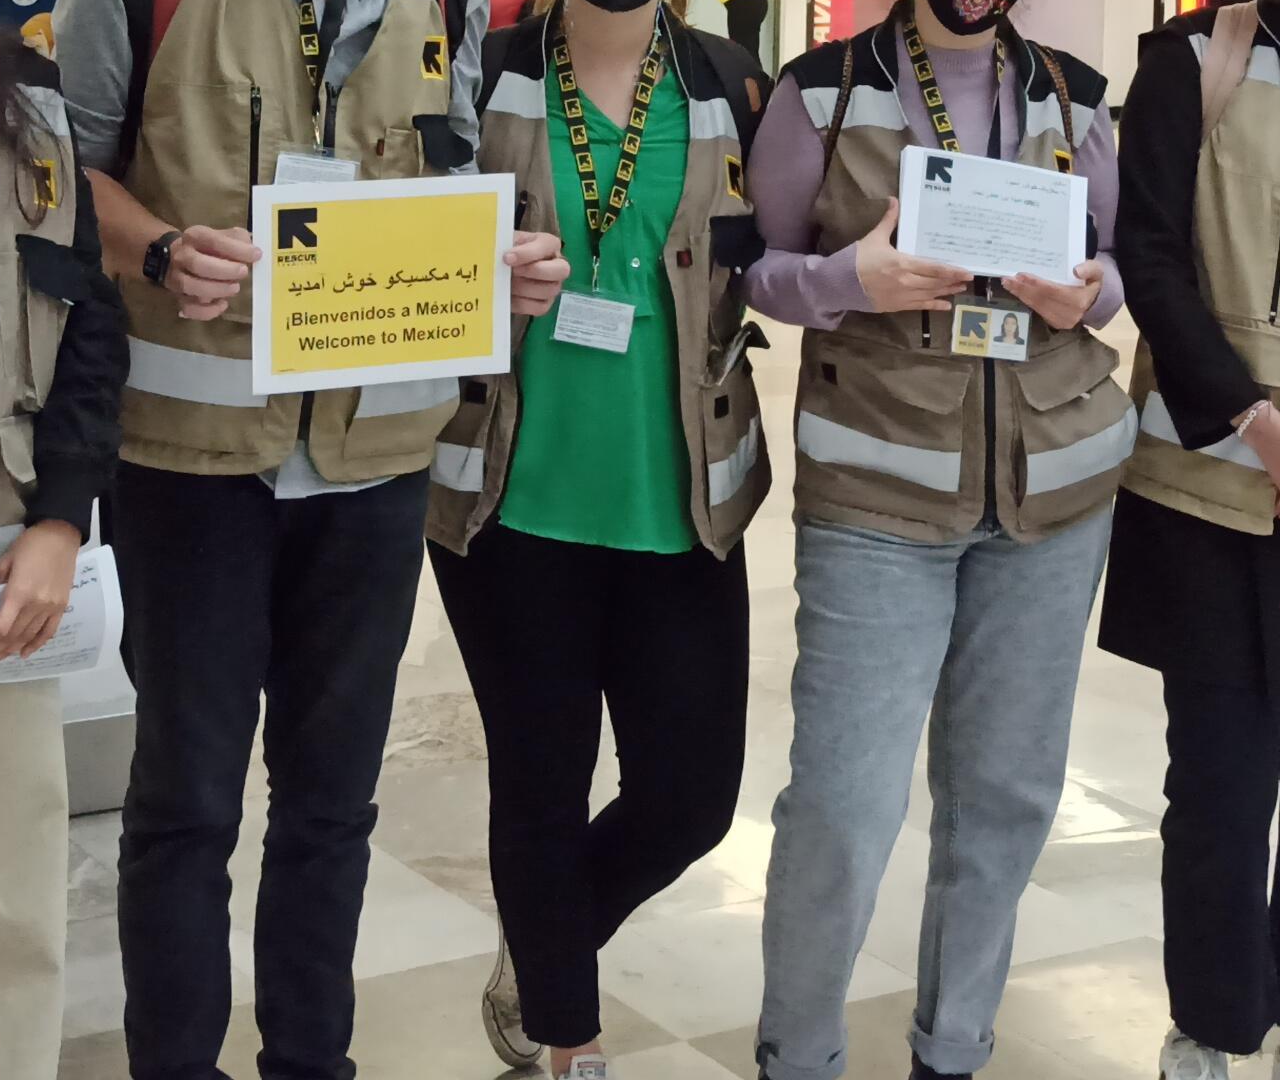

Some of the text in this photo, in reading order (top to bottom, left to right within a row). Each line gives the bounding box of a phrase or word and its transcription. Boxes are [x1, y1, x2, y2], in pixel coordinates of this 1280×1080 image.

[277, 253, 317, 264] RESCUE
[285, 298, 480, 330] ¡Bienvenidos a México!
[298, 324, 466, 351] Welcome to Mexico!
